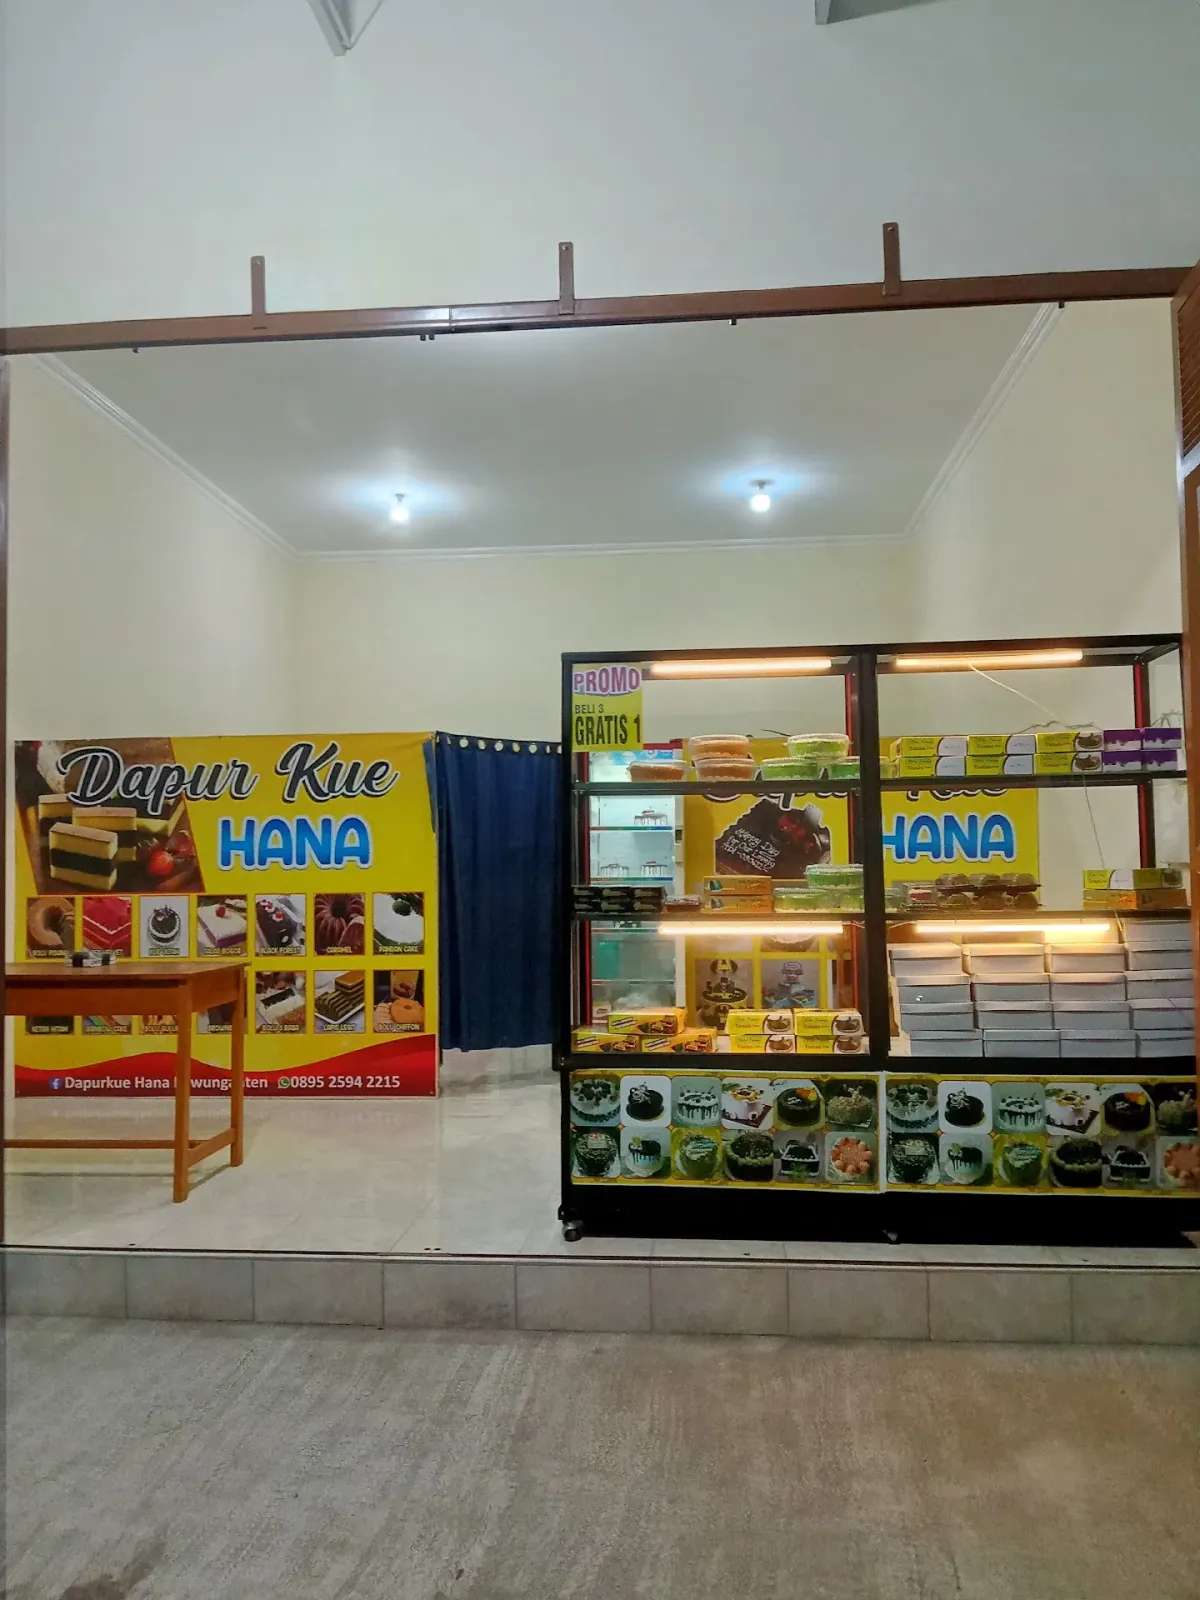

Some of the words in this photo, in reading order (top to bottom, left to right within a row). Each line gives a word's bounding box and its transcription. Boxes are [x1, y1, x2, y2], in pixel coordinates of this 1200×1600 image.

[574, 666, 641, 694] PROMO
[574, 704, 596, 714] BELI
[598, 703, 605, 714] 3
[575, 714, 628, 746] GRATIS
[633, 713, 641, 744] 1
[57, 745, 258, 815] Dapur
[275, 741, 399, 803] Kue
[218, 815, 373, 871] HANA
[734, 828, 762, 848] Happy
[760, 841, 781, 858] Day
[883, 812, 1016, 863] HANA
[279, 946, 301, 954] FOREST
[326, 946, 353, 954] CARAMEL
[378, 945, 403, 953] PANDAN
[403, 945, 419, 953] CAKE
[323, 1023, 339, 1031] LAPIS
[65, 1076, 131, 1093] Dapurkue
[135, 1077, 170, 1089] Hana
[291, 1076, 325, 1089] 0895
[328, 1075, 362, 1089] 2594
[366, 1075, 401, 1088] 2215
